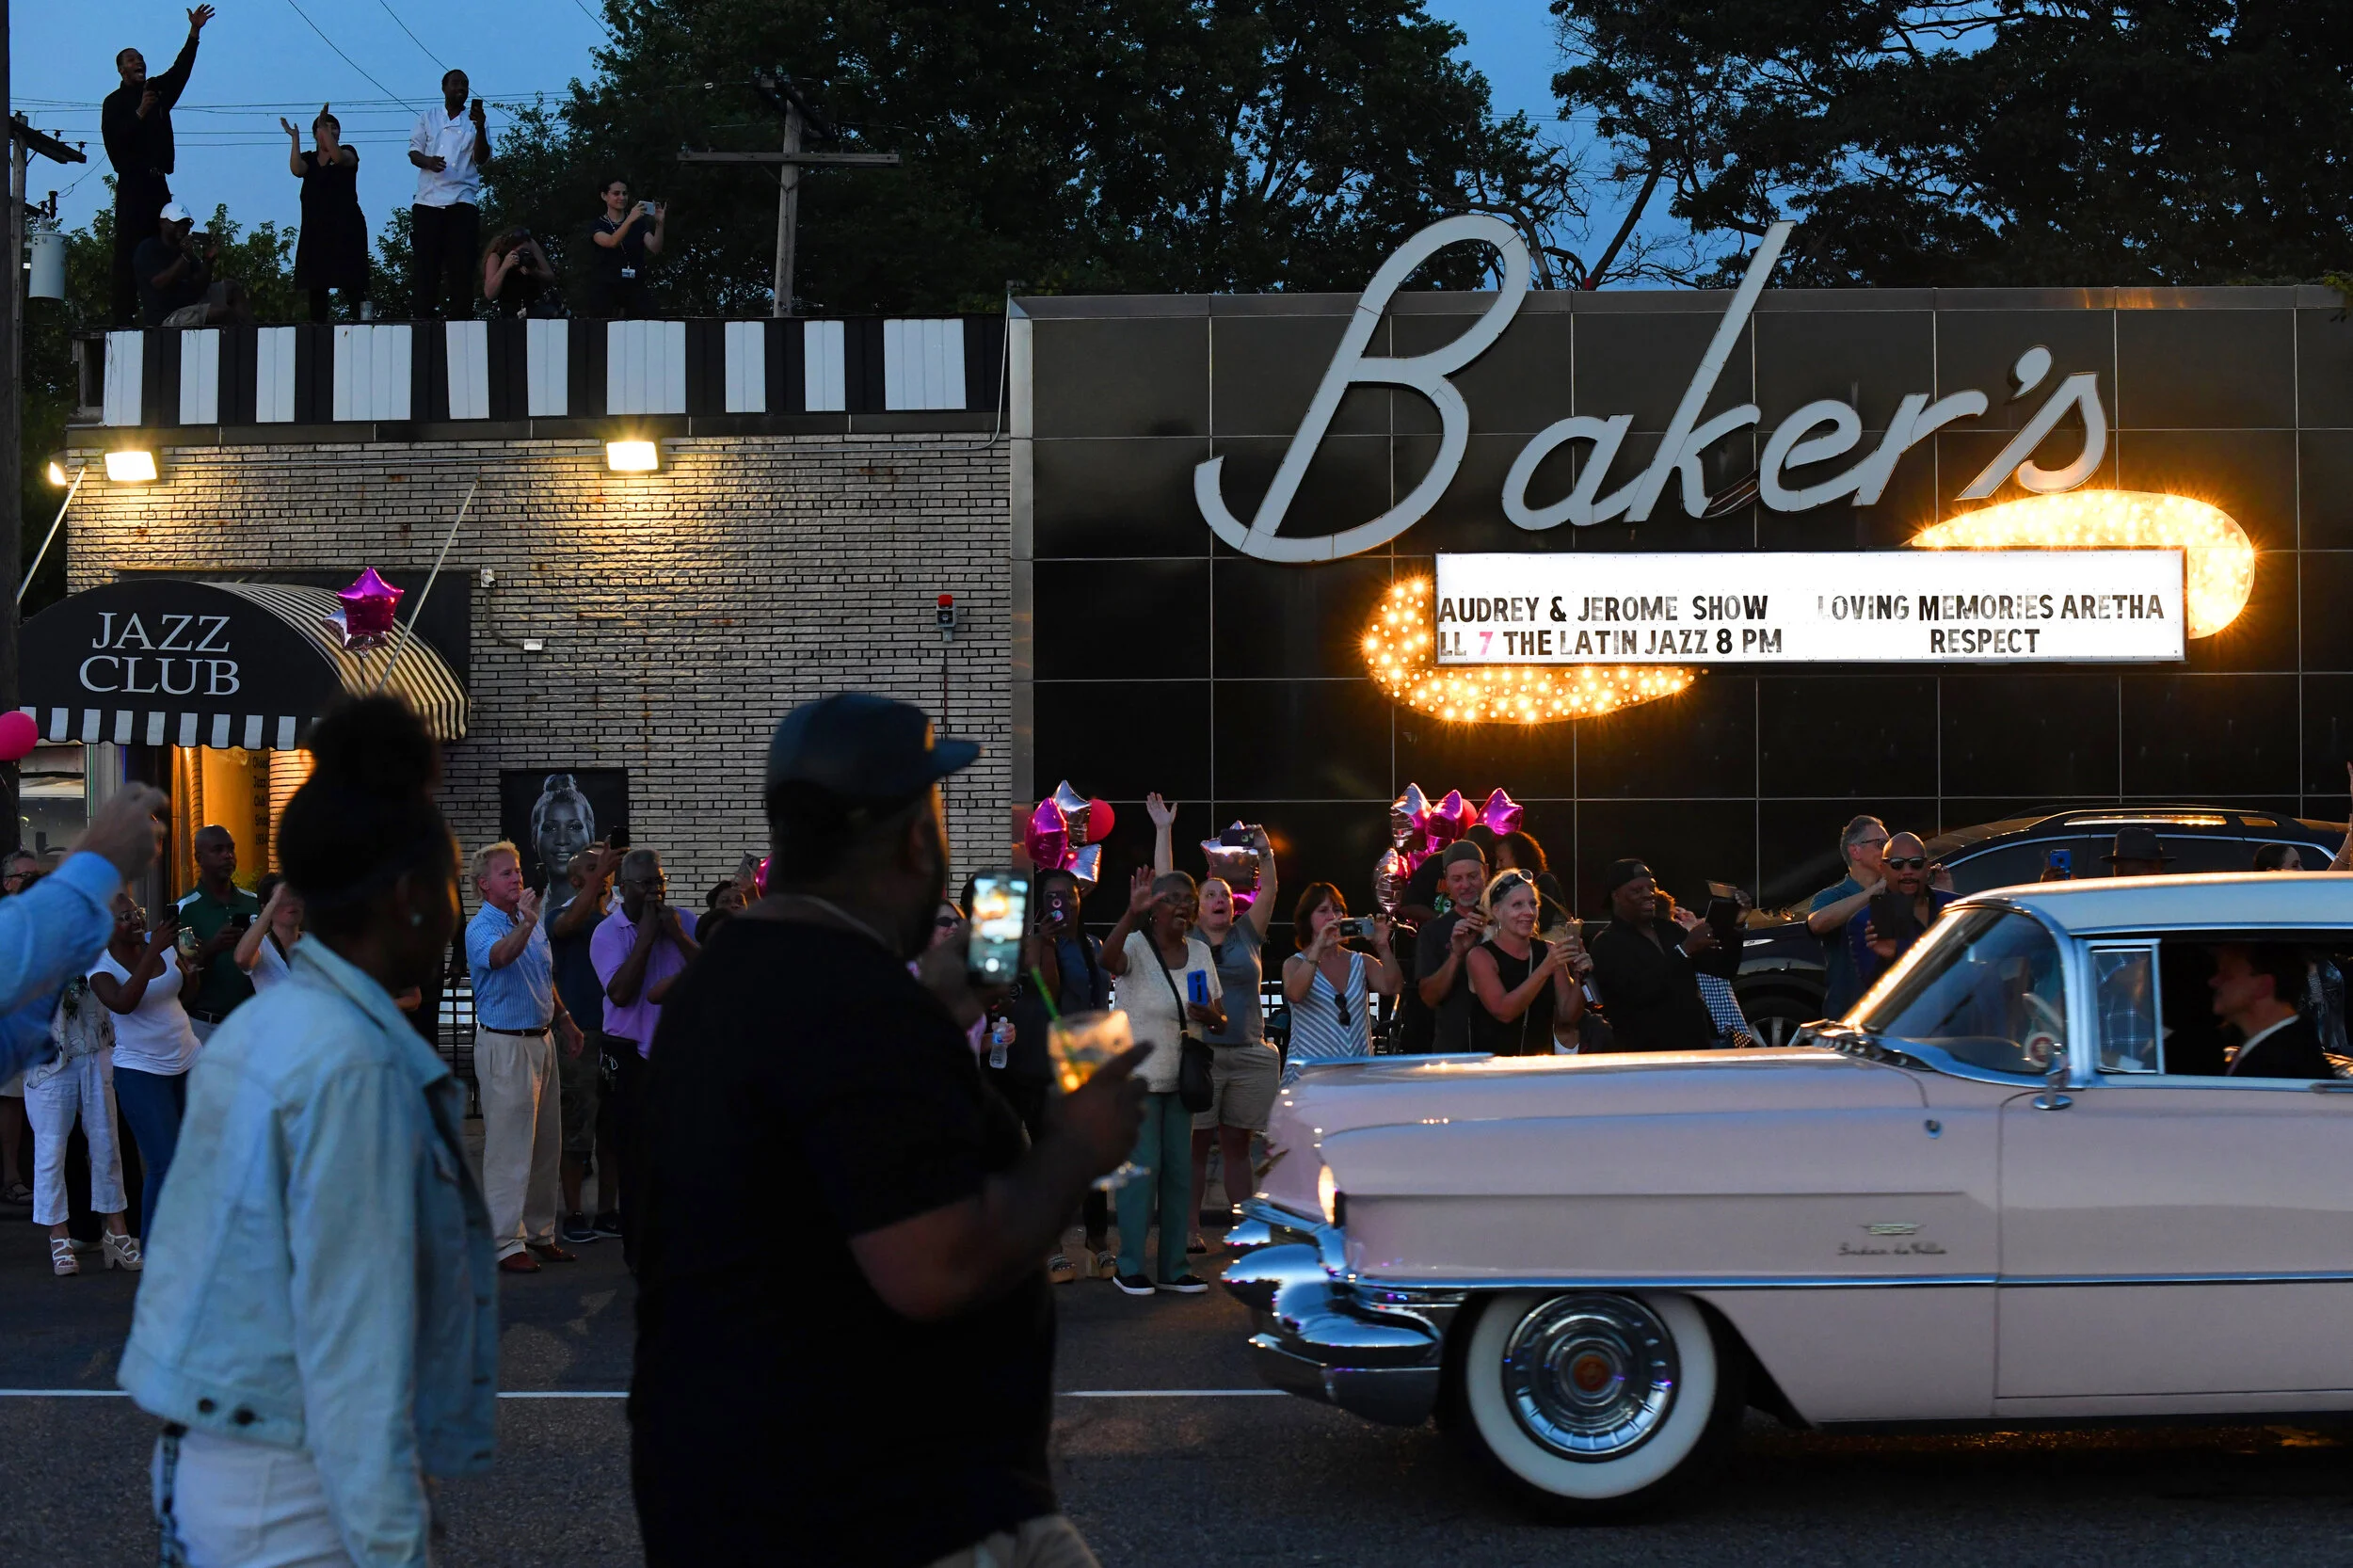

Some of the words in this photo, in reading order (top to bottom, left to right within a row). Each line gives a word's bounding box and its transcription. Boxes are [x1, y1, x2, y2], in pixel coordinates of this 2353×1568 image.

[1194, 215, 2108, 563] Baker's
[1438, 597, 1540, 622] AUDREY
[1549, 596, 1567, 622] &
[1577, 596, 1677, 621] JEROME
[1692, 595, 1769, 620] SHOW
[1817, 595, 1910, 620] LOVING
[1918, 594, 2054, 621] MEMORIES
[2060, 594, 2165, 619] ARETHA
[92, 612, 231, 652] JAZZ
[1440, 632, 1466, 657] LL
[1479, 631, 1494, 656] 7
[1503, 631, 1553, 656] THE
[1560, 630, 1637, 656] LATIN
[1644, 629, 1708, 656] JAZZ
[1716, 628, 1733, 654] 8
[1742, 629, 1782, 654] PM
[1930, 628, 2041, 654] RESPECT
[79, 655, 240, 696] CLUB
